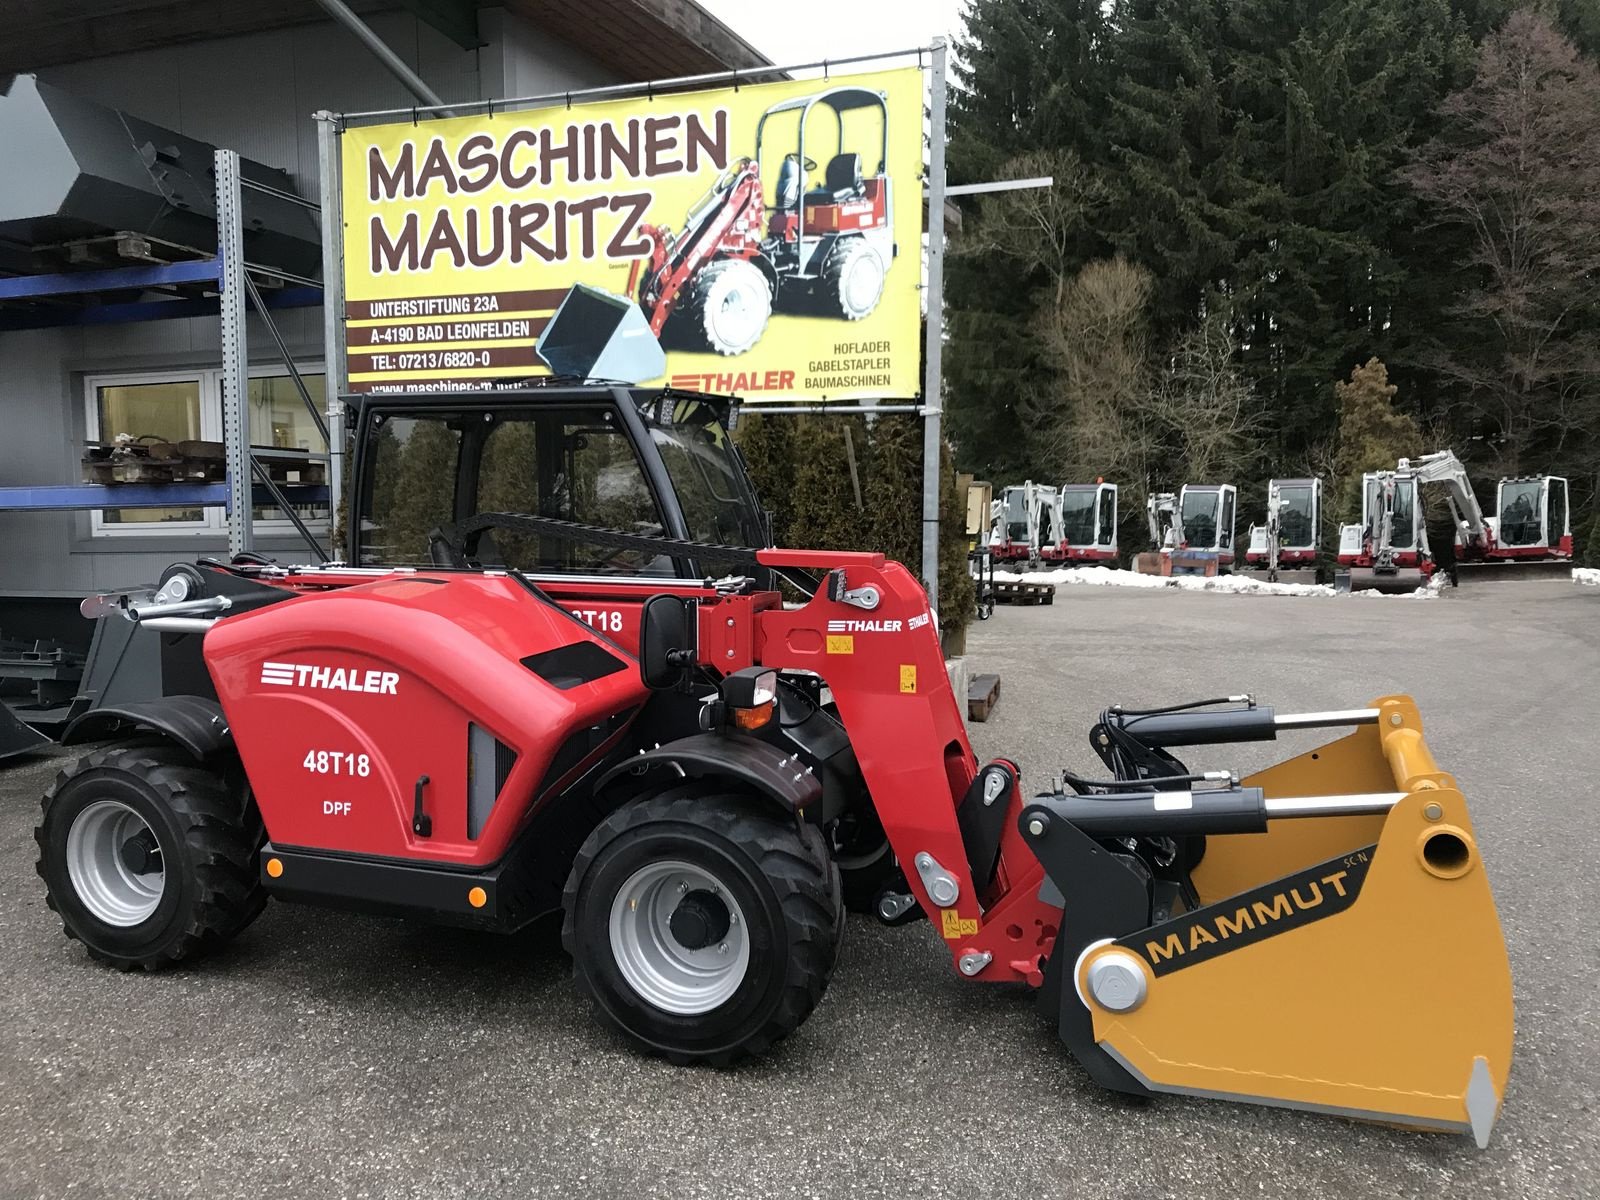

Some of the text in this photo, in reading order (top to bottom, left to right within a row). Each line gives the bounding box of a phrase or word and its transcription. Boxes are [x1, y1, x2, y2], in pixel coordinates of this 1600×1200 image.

[369, 110, 727, 201] MASCHINEN
[370, 193, 653, 273] MAURITZ
[370, 295, 499, 318] UNTERSTIFTUNG 23A
[370, 321, 530, 343] A-4190 BAD LEONFELDEN
[833, 341, 890, 355] HOFLADER
[371, 355, 397, 370] TEL:
[808, 357, 890, 373] GABELSTAPLER
[700, 370, 796, 392] THALER
[805, 374, 891, 389] BAUMASCHINEN
[846, 620, 902, 632] THALER
[295, 664, 400, 695] THALER
[303, 749, 371, 777] 48T18
[323, 800, 352, 816] DPF
[1144, 870, 1348, 965] MAMMUT
